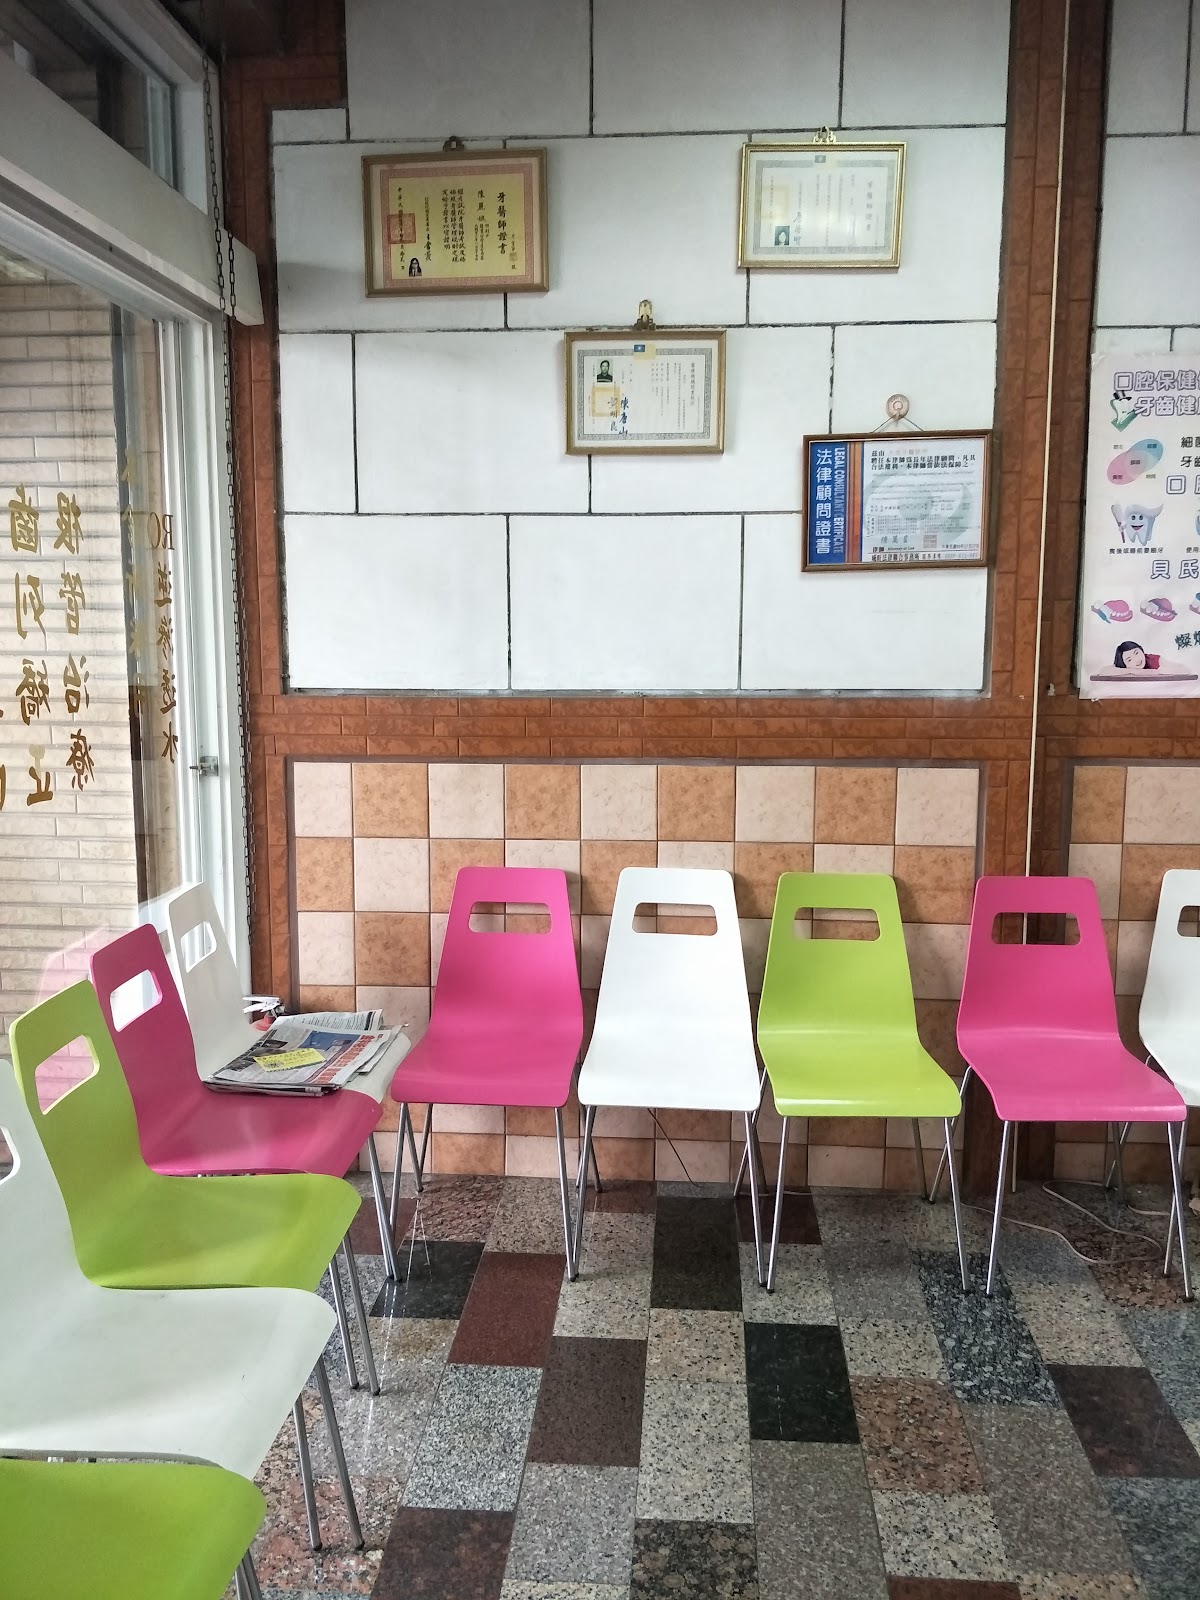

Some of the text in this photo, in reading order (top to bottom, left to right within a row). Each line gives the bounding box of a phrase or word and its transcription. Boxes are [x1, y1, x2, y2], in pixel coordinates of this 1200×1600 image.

[497, 191, 507, 254] 牙醫師證書
[1114, 369, 1200, 392] 口腔保健
[1134, 395, 1200, 416] 牙齒健
[834, 447, 845, 469] LEGAL
[1165, 475, 1200, 495] 口
[815, 448, 832, 554] 法律顧問證書
